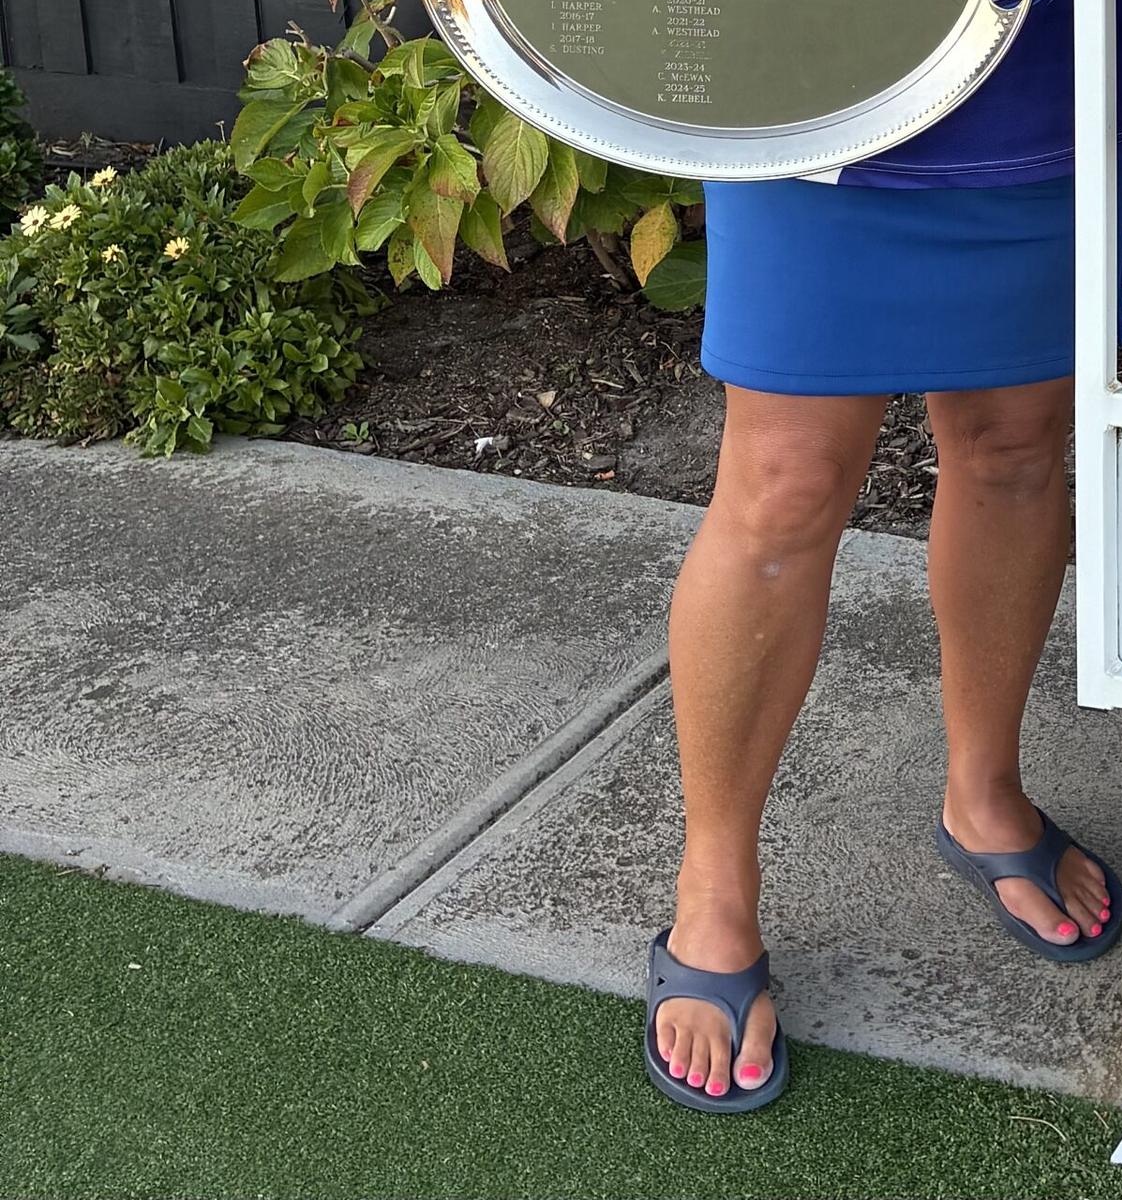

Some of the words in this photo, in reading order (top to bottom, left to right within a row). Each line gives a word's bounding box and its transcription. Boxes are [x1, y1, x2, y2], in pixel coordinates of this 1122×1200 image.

[562, 1, 603, 11] HARPER
[667, 5, 721, 15] WESTHEAD
[666, 16, 706, 26] 2021-22
[667, 27, 720, 37] WESTHEAD
[665, 62, 705, 72] 2023-24
[665, 83, 706, 93] 2024-25
[671, 94, 713, 104] ZIEBELL
